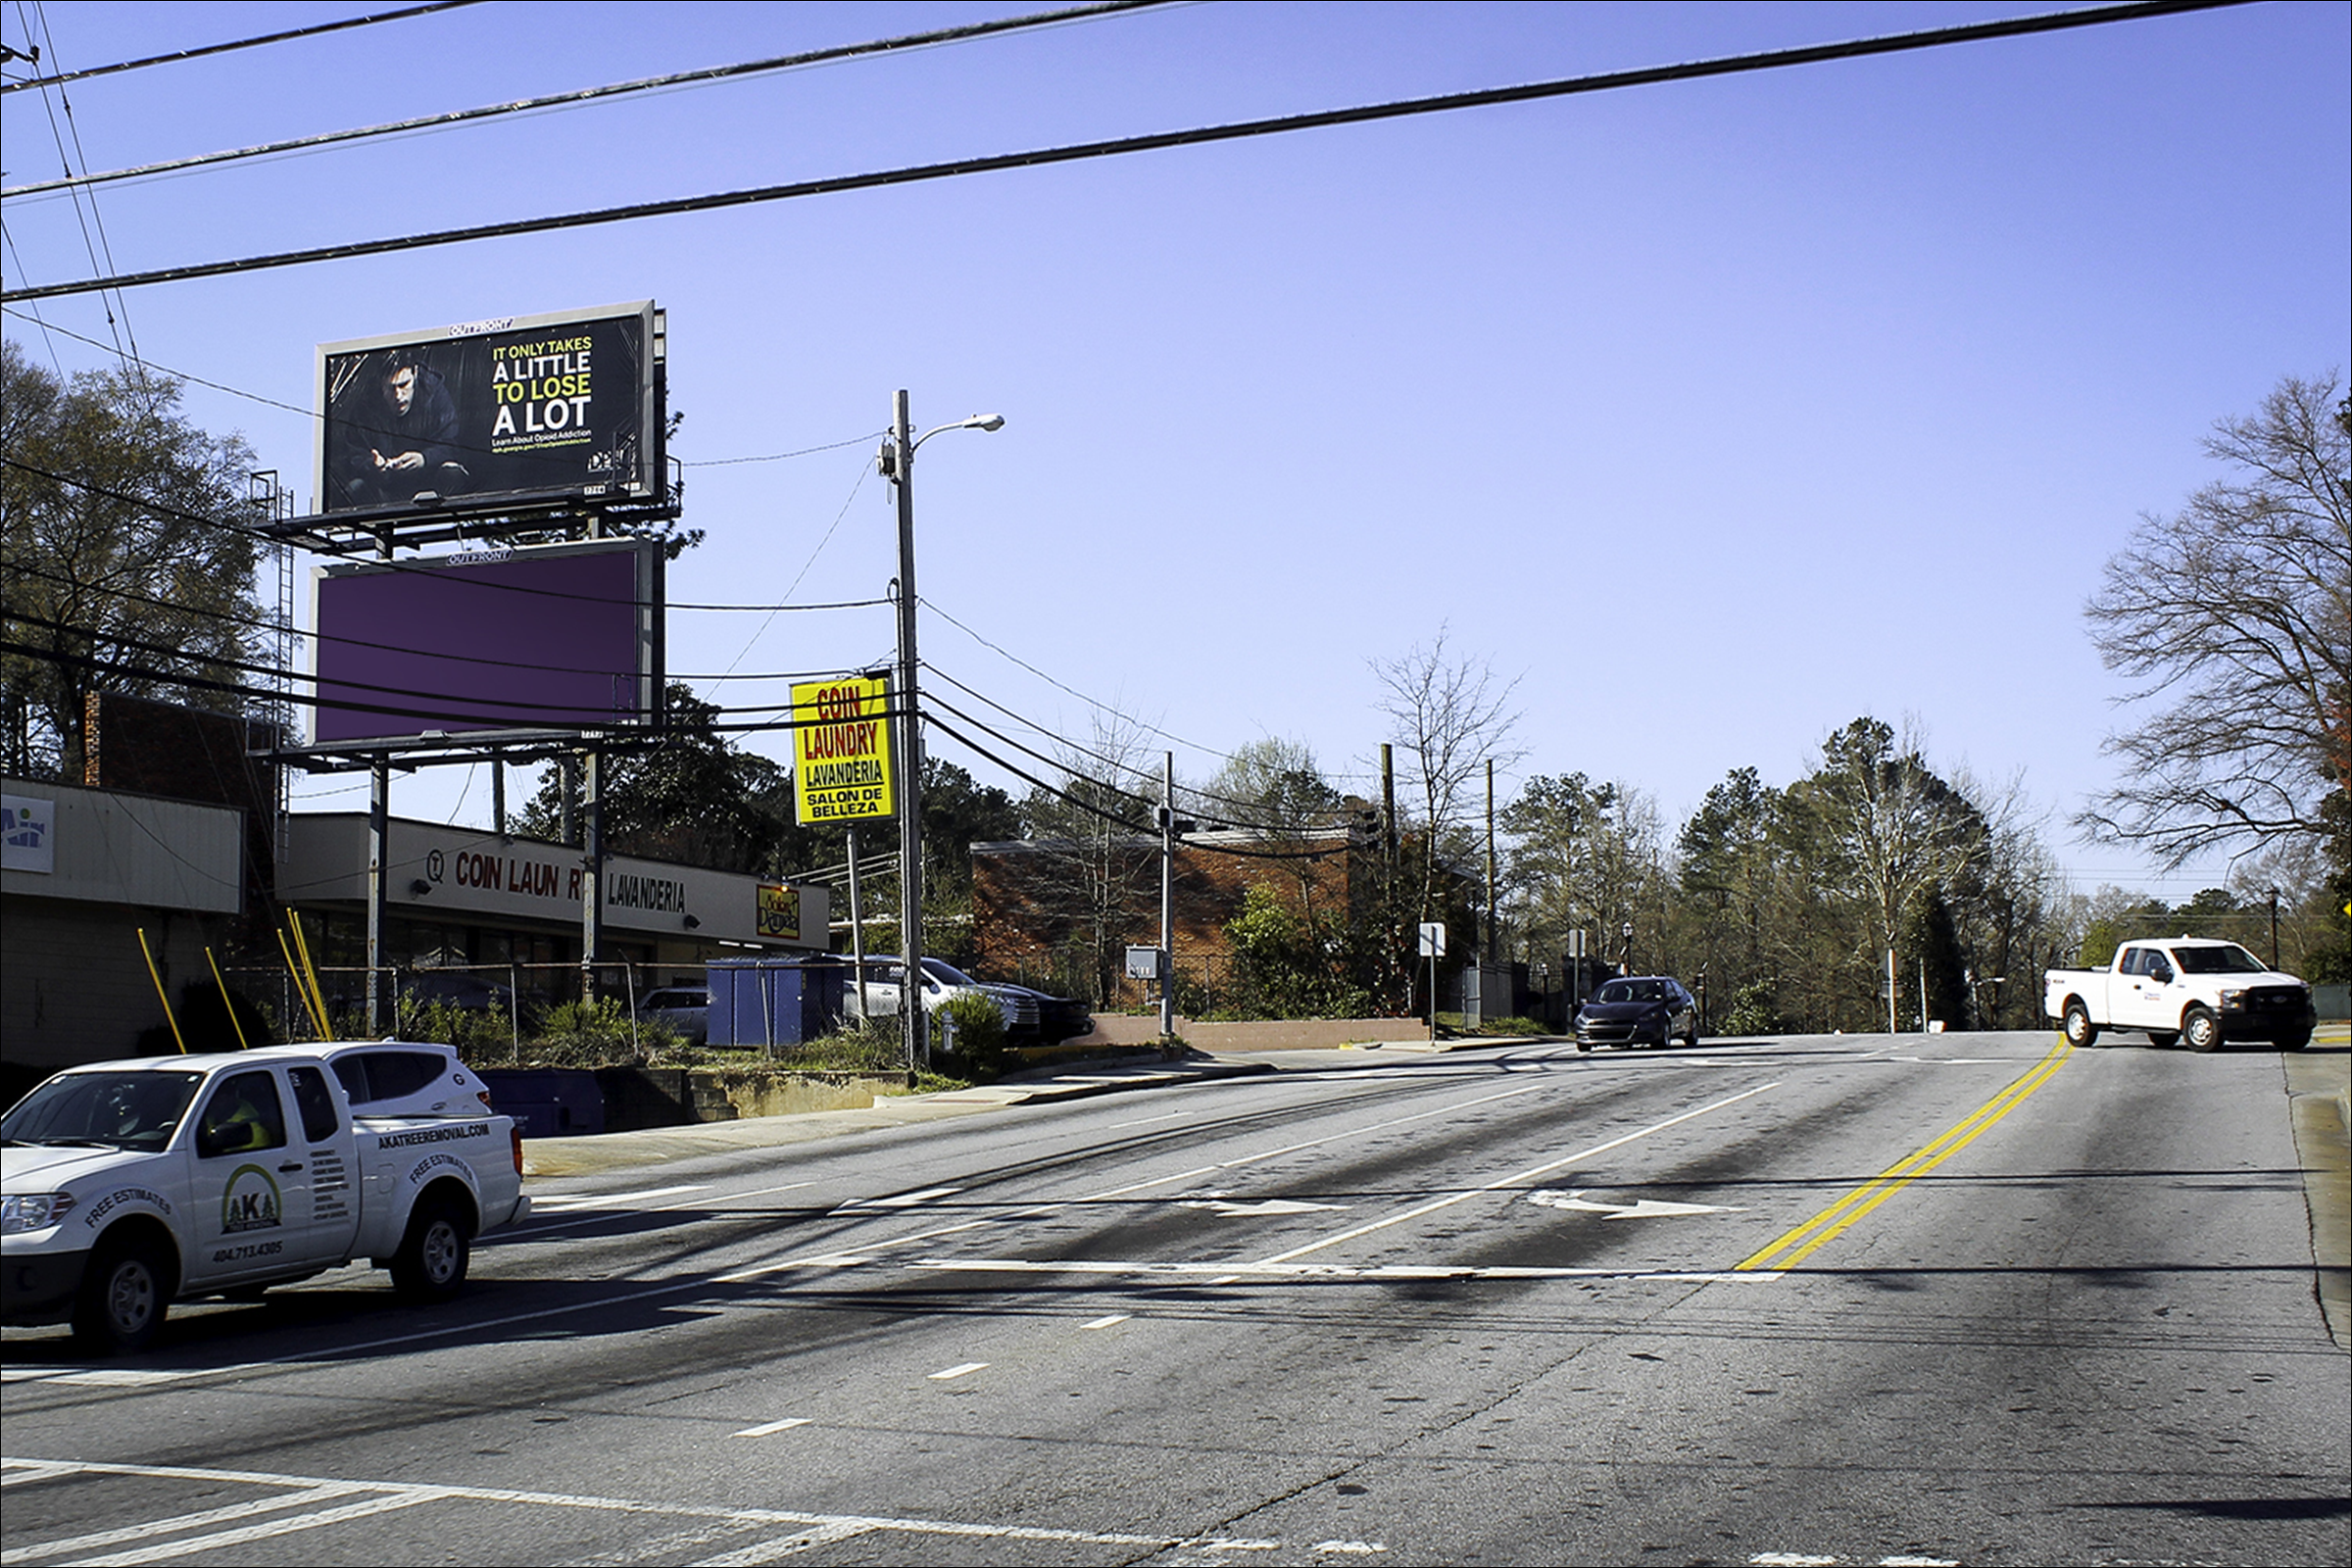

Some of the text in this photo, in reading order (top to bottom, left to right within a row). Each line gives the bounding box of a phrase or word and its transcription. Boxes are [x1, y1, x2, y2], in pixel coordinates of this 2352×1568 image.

[493, 336, 592, 361] IT ONLY TAKES
[493, 351, 591, 383] A LITTLE
[493, 373, 592, 405] TO LOSE
[492, 395, 592, 436] A LOT
[492, 429, 592, 447] Learn About Opioid Addiction
[449, 549, 510, 565] OUTFRONT
[817, 686, 860, 720] COIN
[804, 722, 877, 760] LAUNDRY
[806, 760, 882, 787] LAVANDERIA
[807, 788, 882, 806] SALON DE
[812, 802, 878, 818] BELLEZA
[456, 851, 502, 891] COIN
[608, 873, 685, 913] LAVANDERIA
[378, 1123, 490, 1150] AKATREEREMOVAL.COM
[409, 1153, 472, 1184] FREE ESTIMATES
[84, 1188, 171, 1228] FREE ESTIMATES
